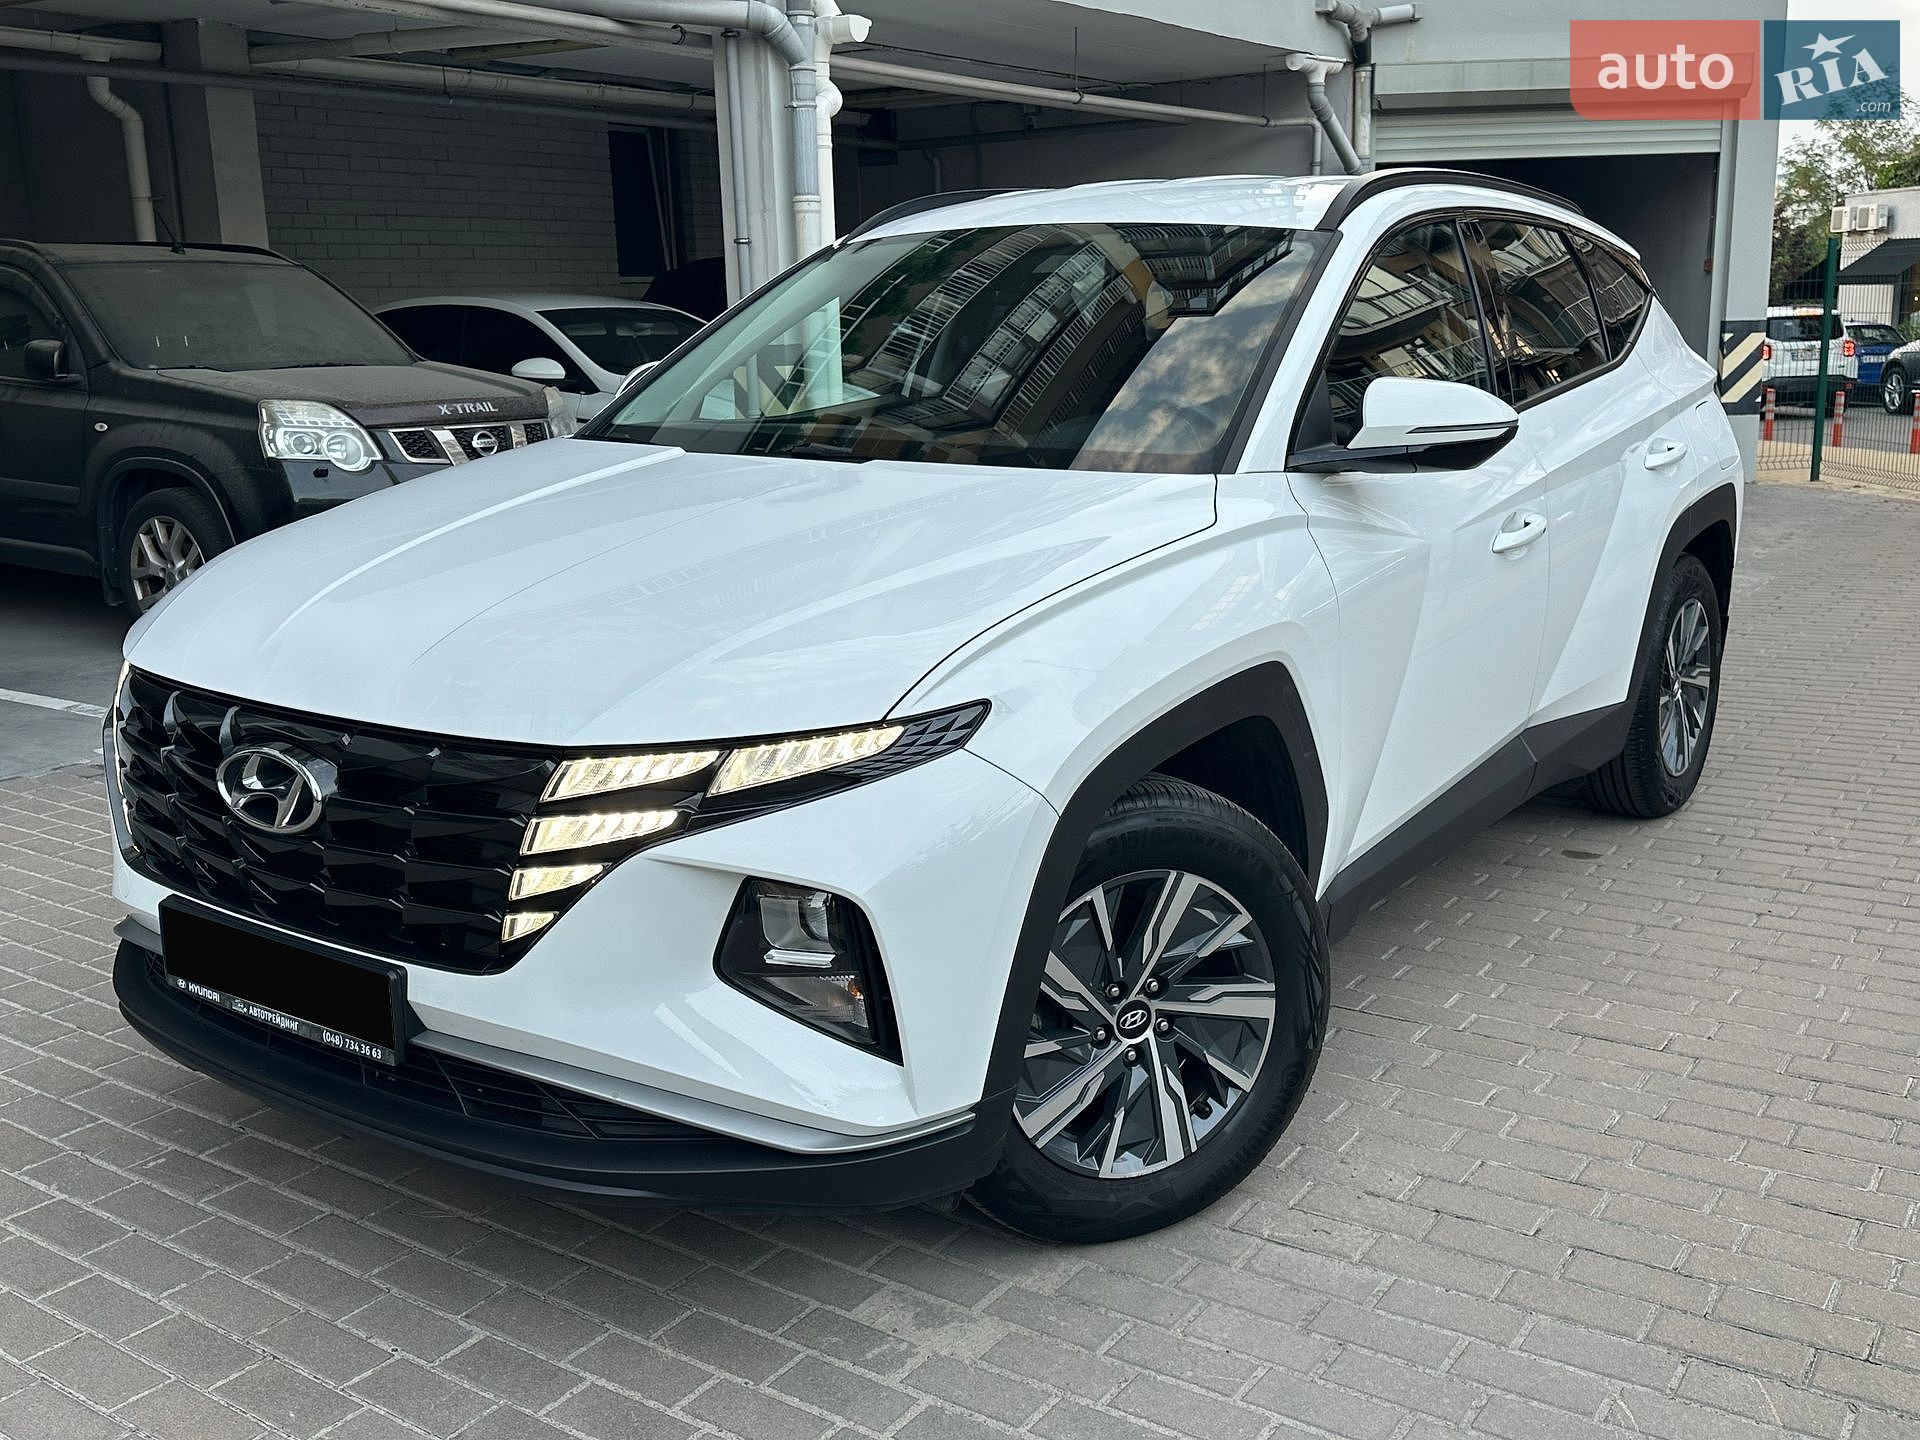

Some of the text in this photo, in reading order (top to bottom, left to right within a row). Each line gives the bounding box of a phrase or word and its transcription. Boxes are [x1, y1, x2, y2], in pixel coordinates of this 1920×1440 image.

[438, 402, 498, 415] X-TRAIL
[188, 982, 220, 1003] HYUNDAI
[248, 1005, 299, 1032] АВТОТРЕЙДИНГ
[322, 1029, 382, 1060] (048) 734 36 63
